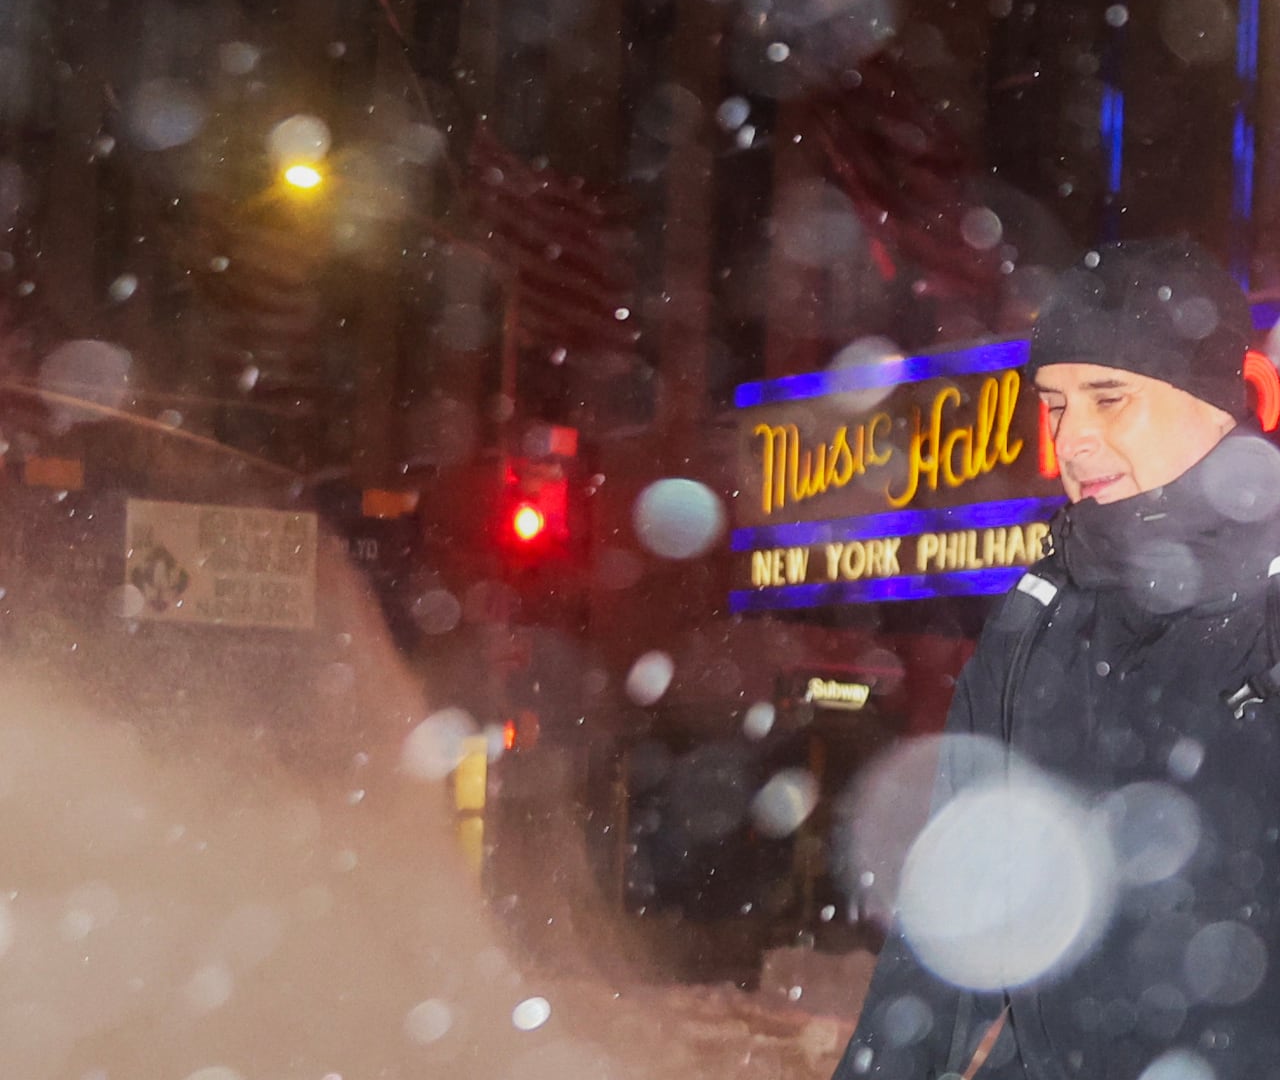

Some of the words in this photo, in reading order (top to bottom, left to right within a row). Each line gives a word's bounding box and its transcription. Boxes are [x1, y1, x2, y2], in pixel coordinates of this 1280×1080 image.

[886, 369, 1024, 508] Hall
[751, 546, 809, 587] NEW
[825, 536, 901, 581] YORK
[916, 522, 1050, 571] PHILHAR
